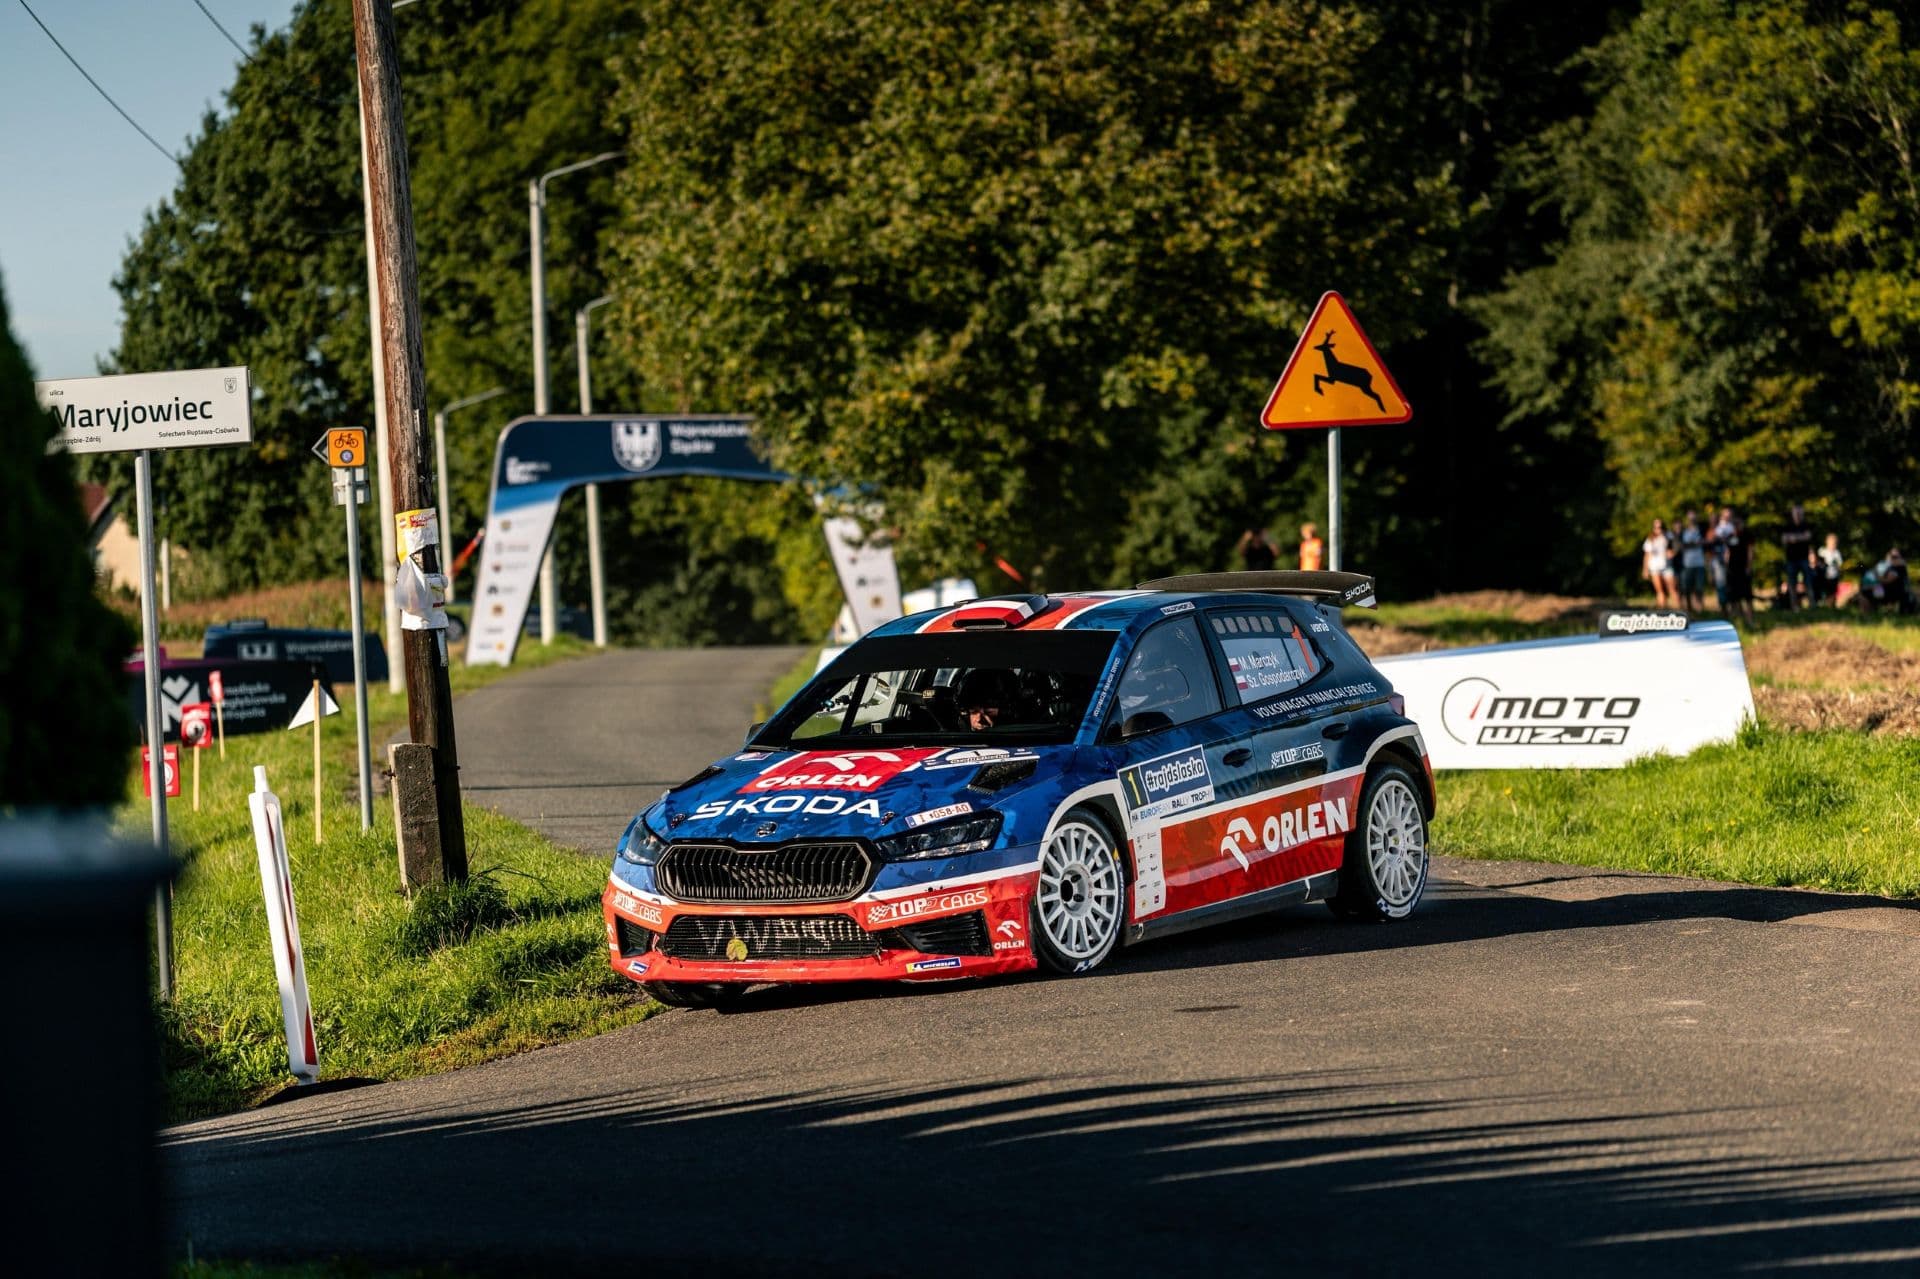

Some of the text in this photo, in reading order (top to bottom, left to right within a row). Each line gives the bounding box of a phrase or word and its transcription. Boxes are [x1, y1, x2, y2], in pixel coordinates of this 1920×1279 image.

[49, 388, 64, 396] ulica
[51, 397, 213, 432] Maryjowiec
[1237, 651, 1280, 670] M. Marczyk
[1258, 666, 1308, 687] Gospodarczyk
[1253, 695, 1311, 718] VOLKSWAGEN
[1307, 687, 1348, 705] FINANCIAL
[1344, 682, 1377, 698] SERVICES
[1487, 698, 1641, 719] MOTO
[1478, 726, 1627, 744] WIZJA
[1280, 744, 1324, 764] TOP CARS
[756, 774, 882, 788] ORLEN
[1127, 757, 1205, 806] 1 #rajdslaska
[687, 795, 881, 820] SKODA
[1171, 796, 1190, 809] RALLY
[1262, 797, 1350, 853] ORLEN
[640, 904, 663, 924] CARS
[889, 891, 989, 917] TOP CARS
[993, 940, 1025, 950] ORLEN
